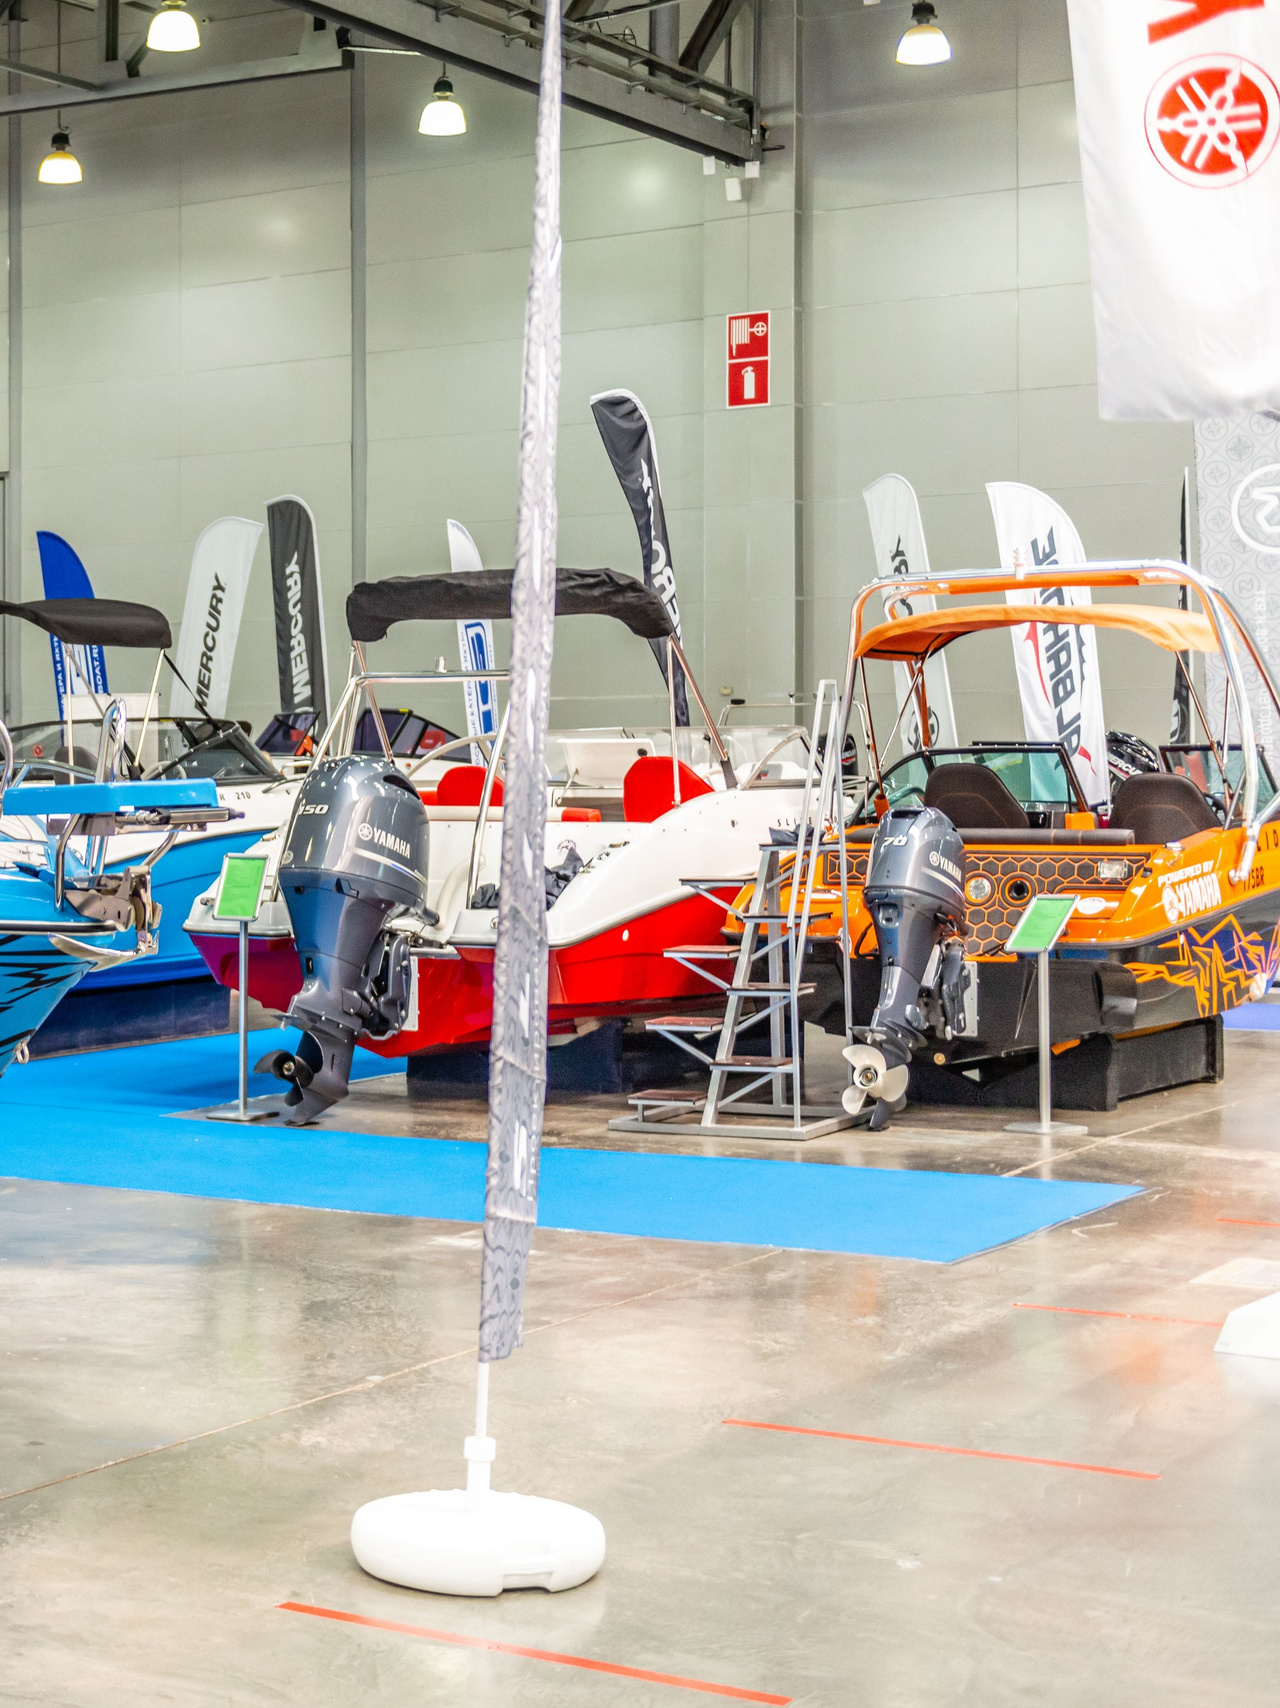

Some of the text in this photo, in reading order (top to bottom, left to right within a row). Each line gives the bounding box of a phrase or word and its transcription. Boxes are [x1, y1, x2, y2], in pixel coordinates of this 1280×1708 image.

[194, 571, 227, 711] MERCURY
[235, 791, 252, 800] 210
[373, 827, 411, 860] YAMAHA
[883, 835, 909, 847] 70
[1157, 859, 1214, 888] POWERED BY
[1175, 872, 1222, 917] YAMAHA
